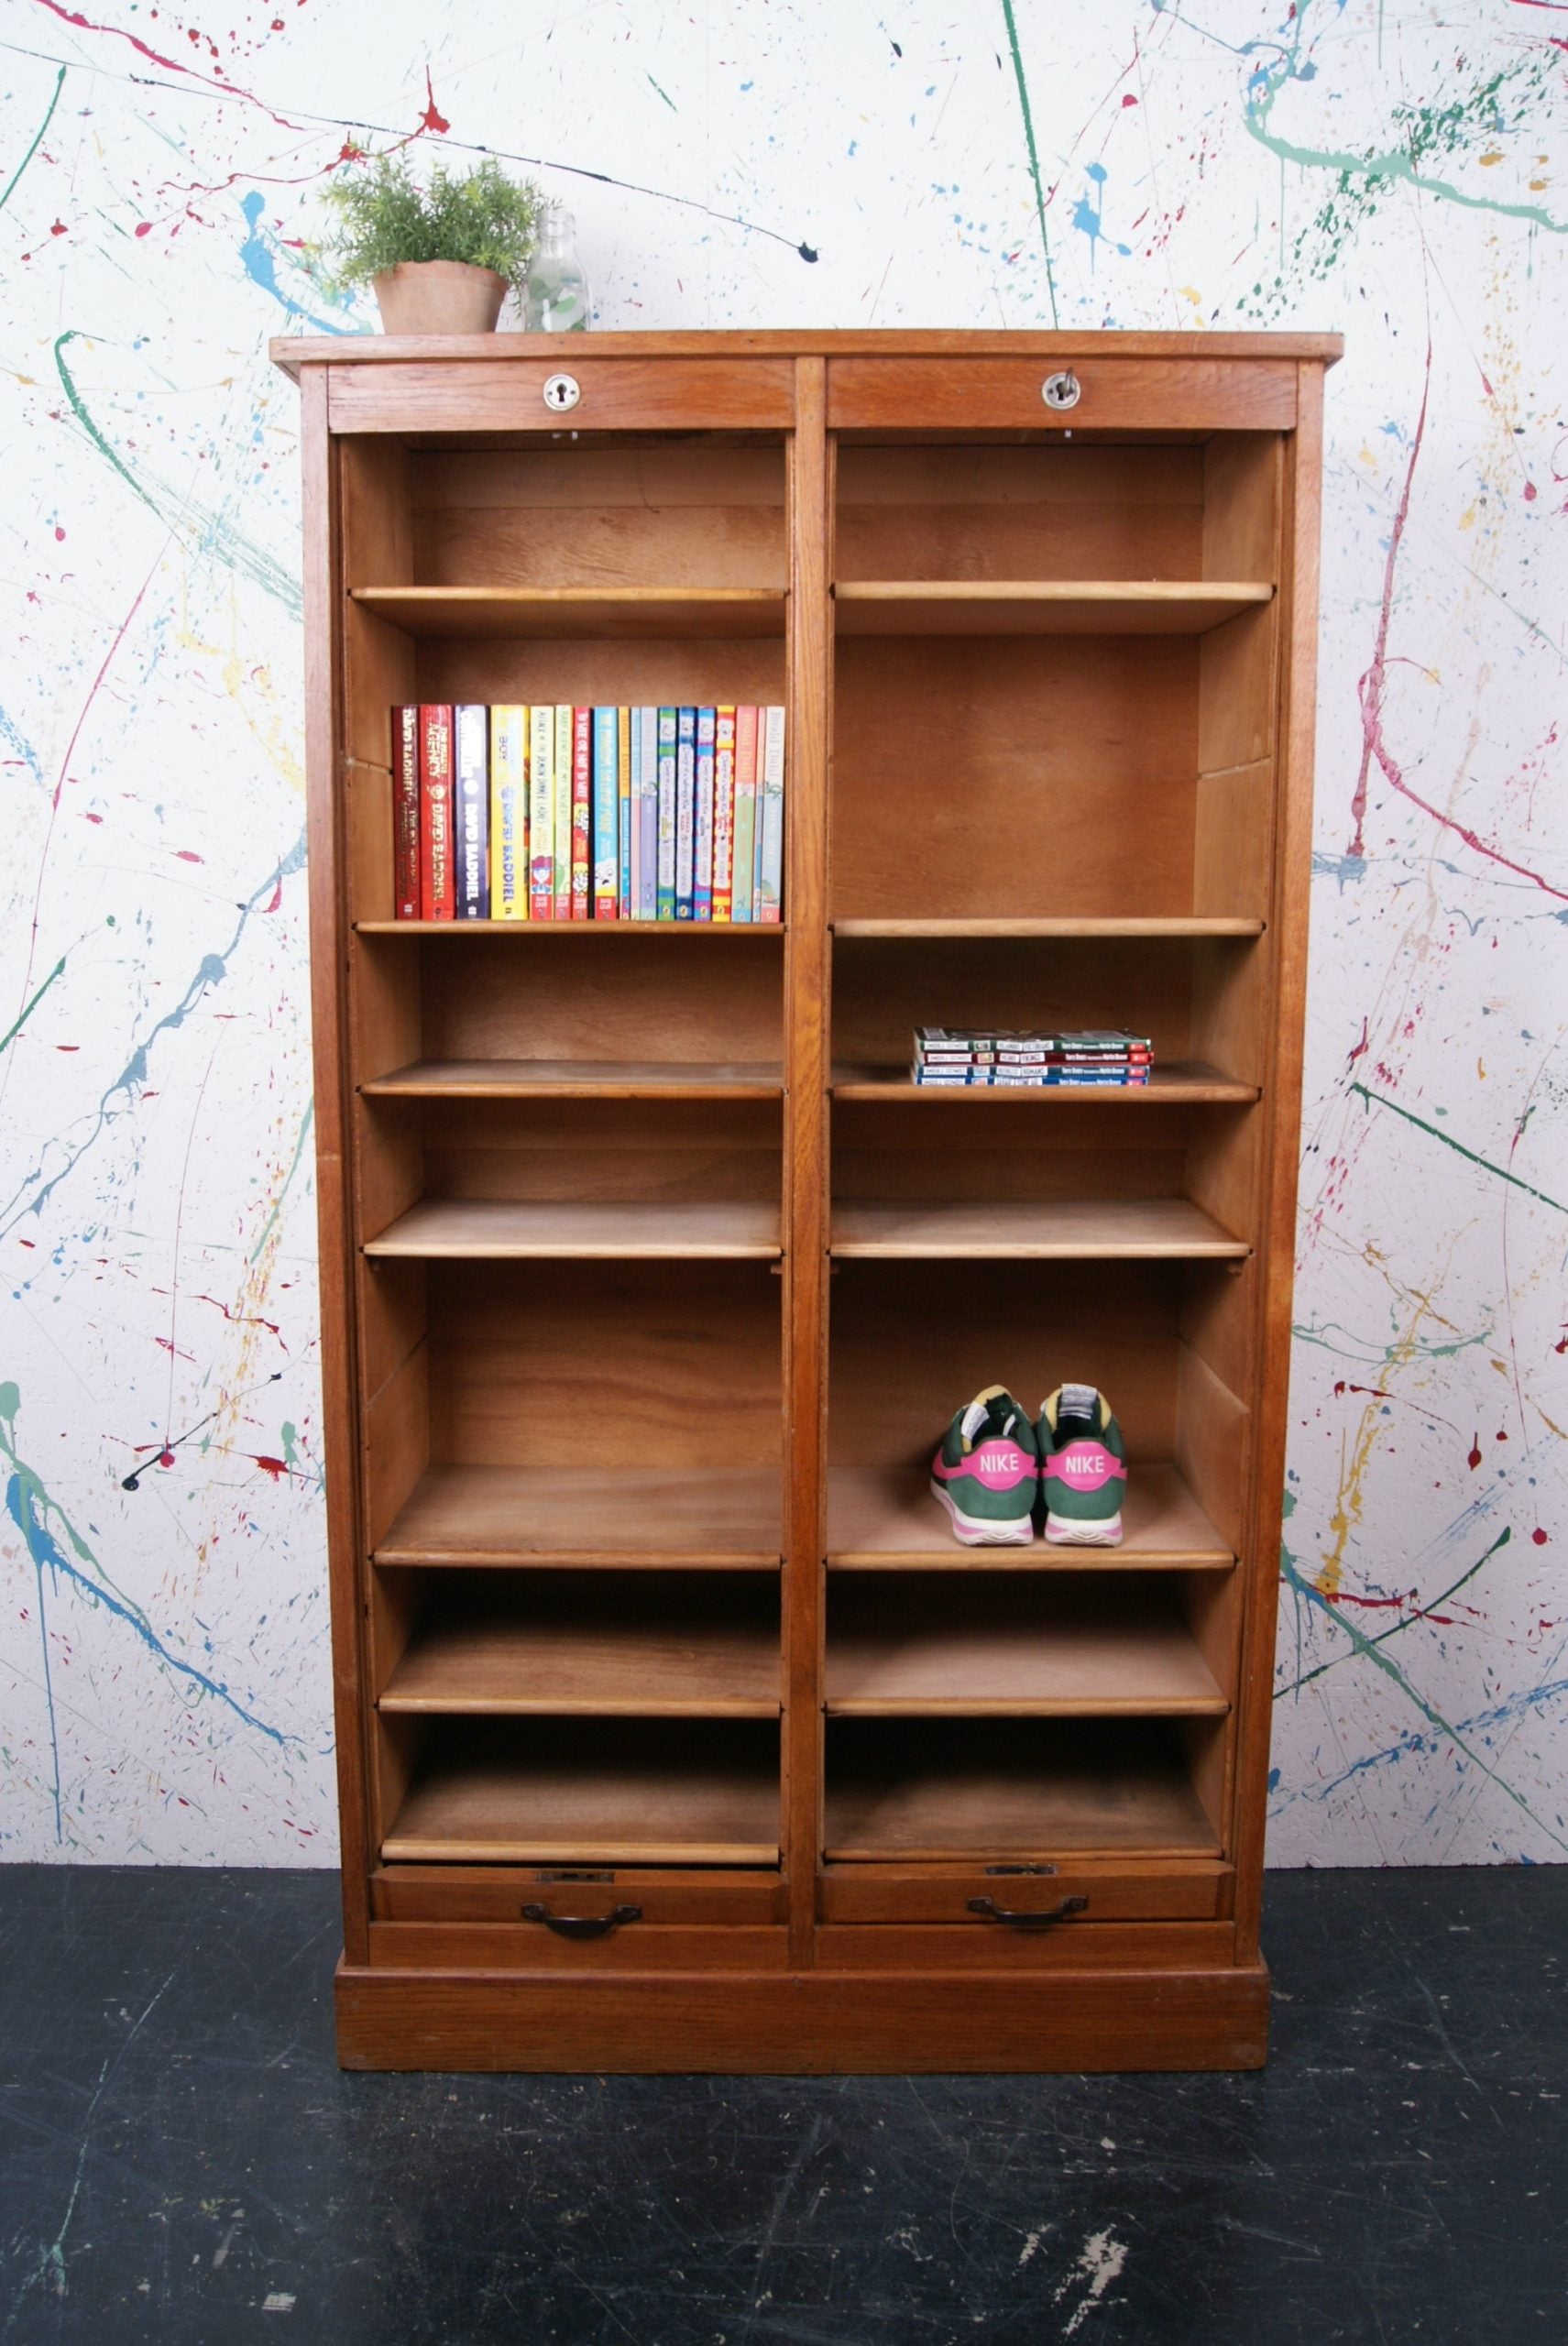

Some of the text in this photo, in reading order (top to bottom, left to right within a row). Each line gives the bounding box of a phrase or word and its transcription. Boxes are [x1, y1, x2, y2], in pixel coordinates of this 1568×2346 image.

[427, 722, 441, 778] AGENCY
[577, 740, 588, 752] OR
[577, 754, 587, 768] NOT
[740, 714, 753, 779] Roald Dahl
[768, 712, 782, 777] Roald Dahl
[432, 804, 444, 901] DAVID BADDIEL
[466, 804, 478, 901] DAVID BADDIEL
[503, 845, 515, 903] BADDIEL
[981, 1453, 1019, 1473] NIKE
[1066, 1455, 1104, 1474] NIKE
